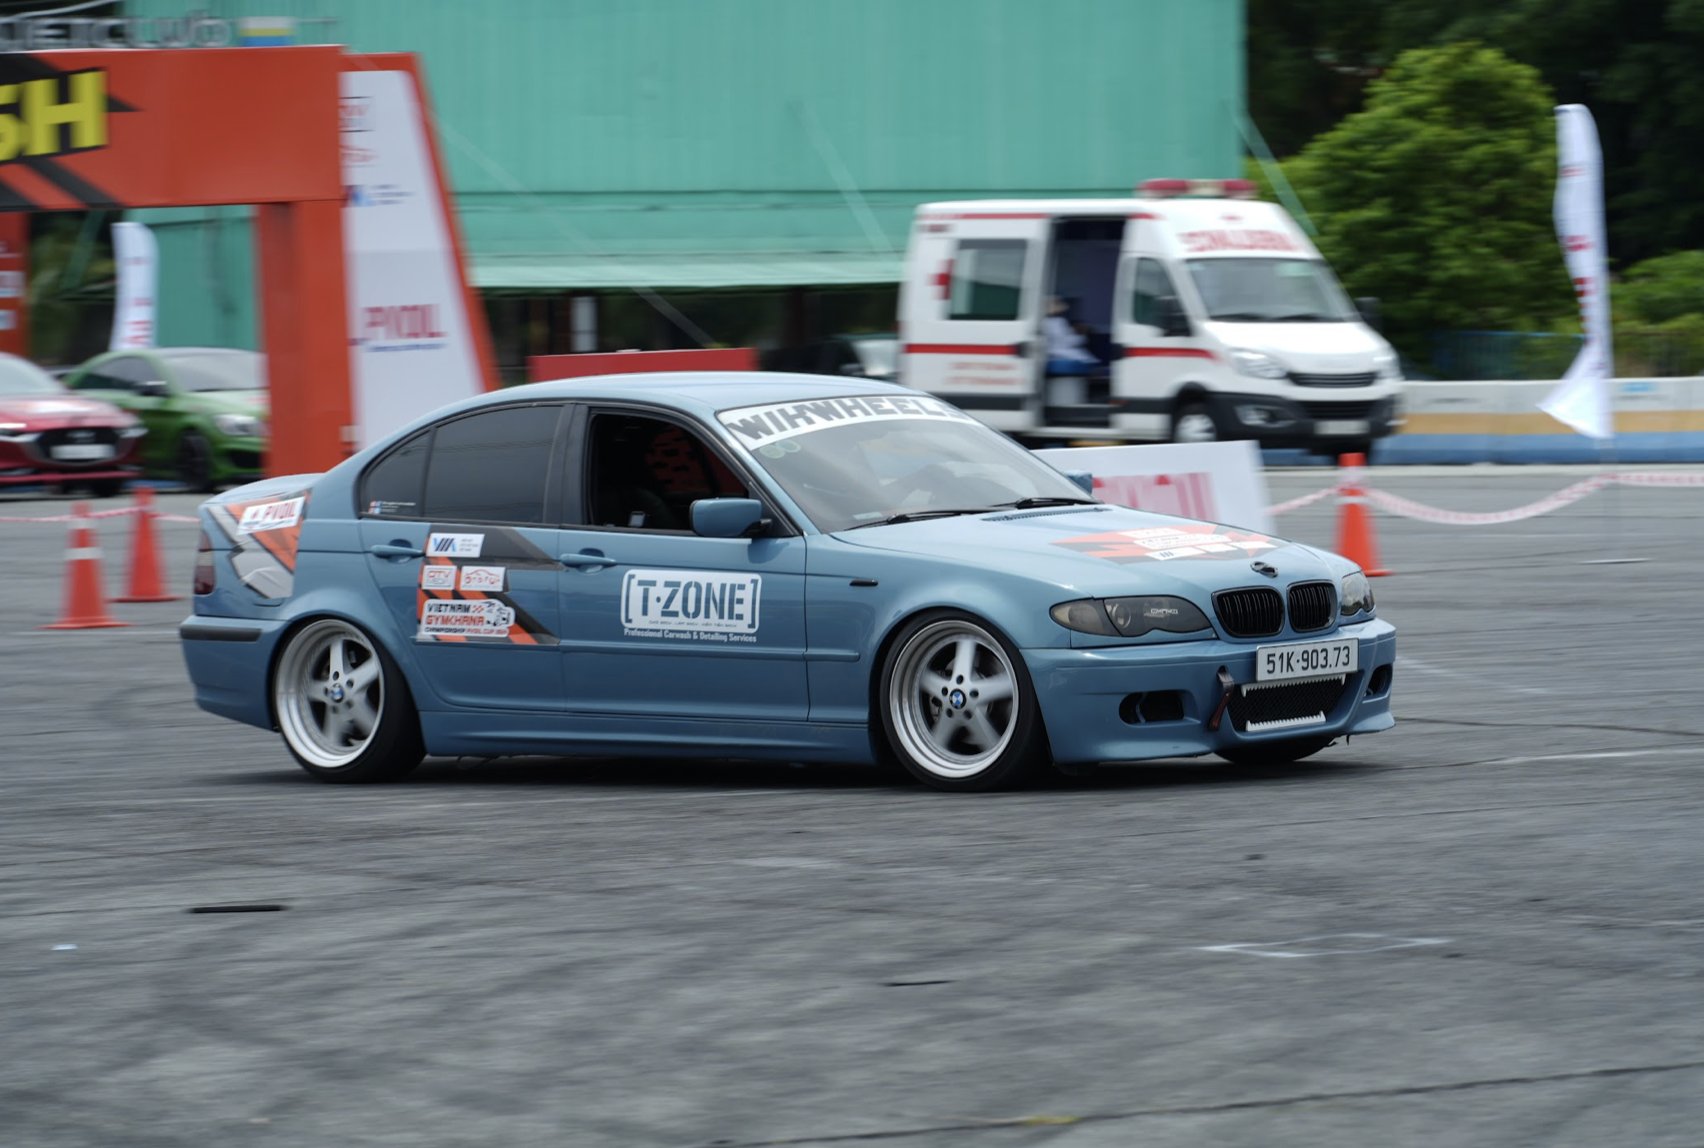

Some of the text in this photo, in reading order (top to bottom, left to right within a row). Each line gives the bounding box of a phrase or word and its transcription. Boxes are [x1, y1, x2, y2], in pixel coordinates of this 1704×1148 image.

[427, 603, 471, 613] VIETNAM
[426, 615, 485, 626] GYMKHANA
[624, 628, 663, 638] Professional
[664, 630, 691, 640] Carwash
[700, 632, 728, 643] Detailing
[729, 634, 757, 643] Services
